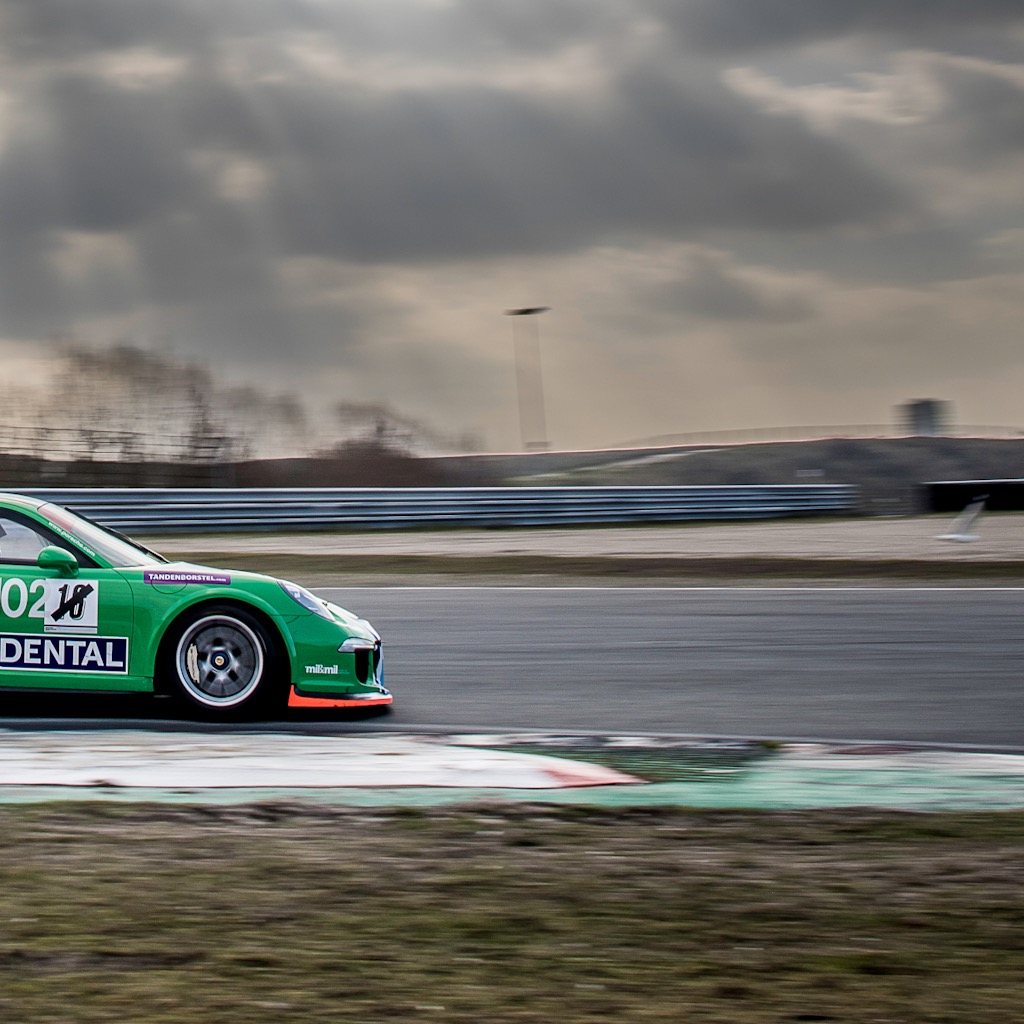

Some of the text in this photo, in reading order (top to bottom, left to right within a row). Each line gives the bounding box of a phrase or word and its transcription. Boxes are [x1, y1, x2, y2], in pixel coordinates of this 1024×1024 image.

[48, 521, 95, 557] www.porsche.com
[148, 573, 227, 582] TANDENBORSTEL.com
[0, 637, 124, 667] DENTAL
